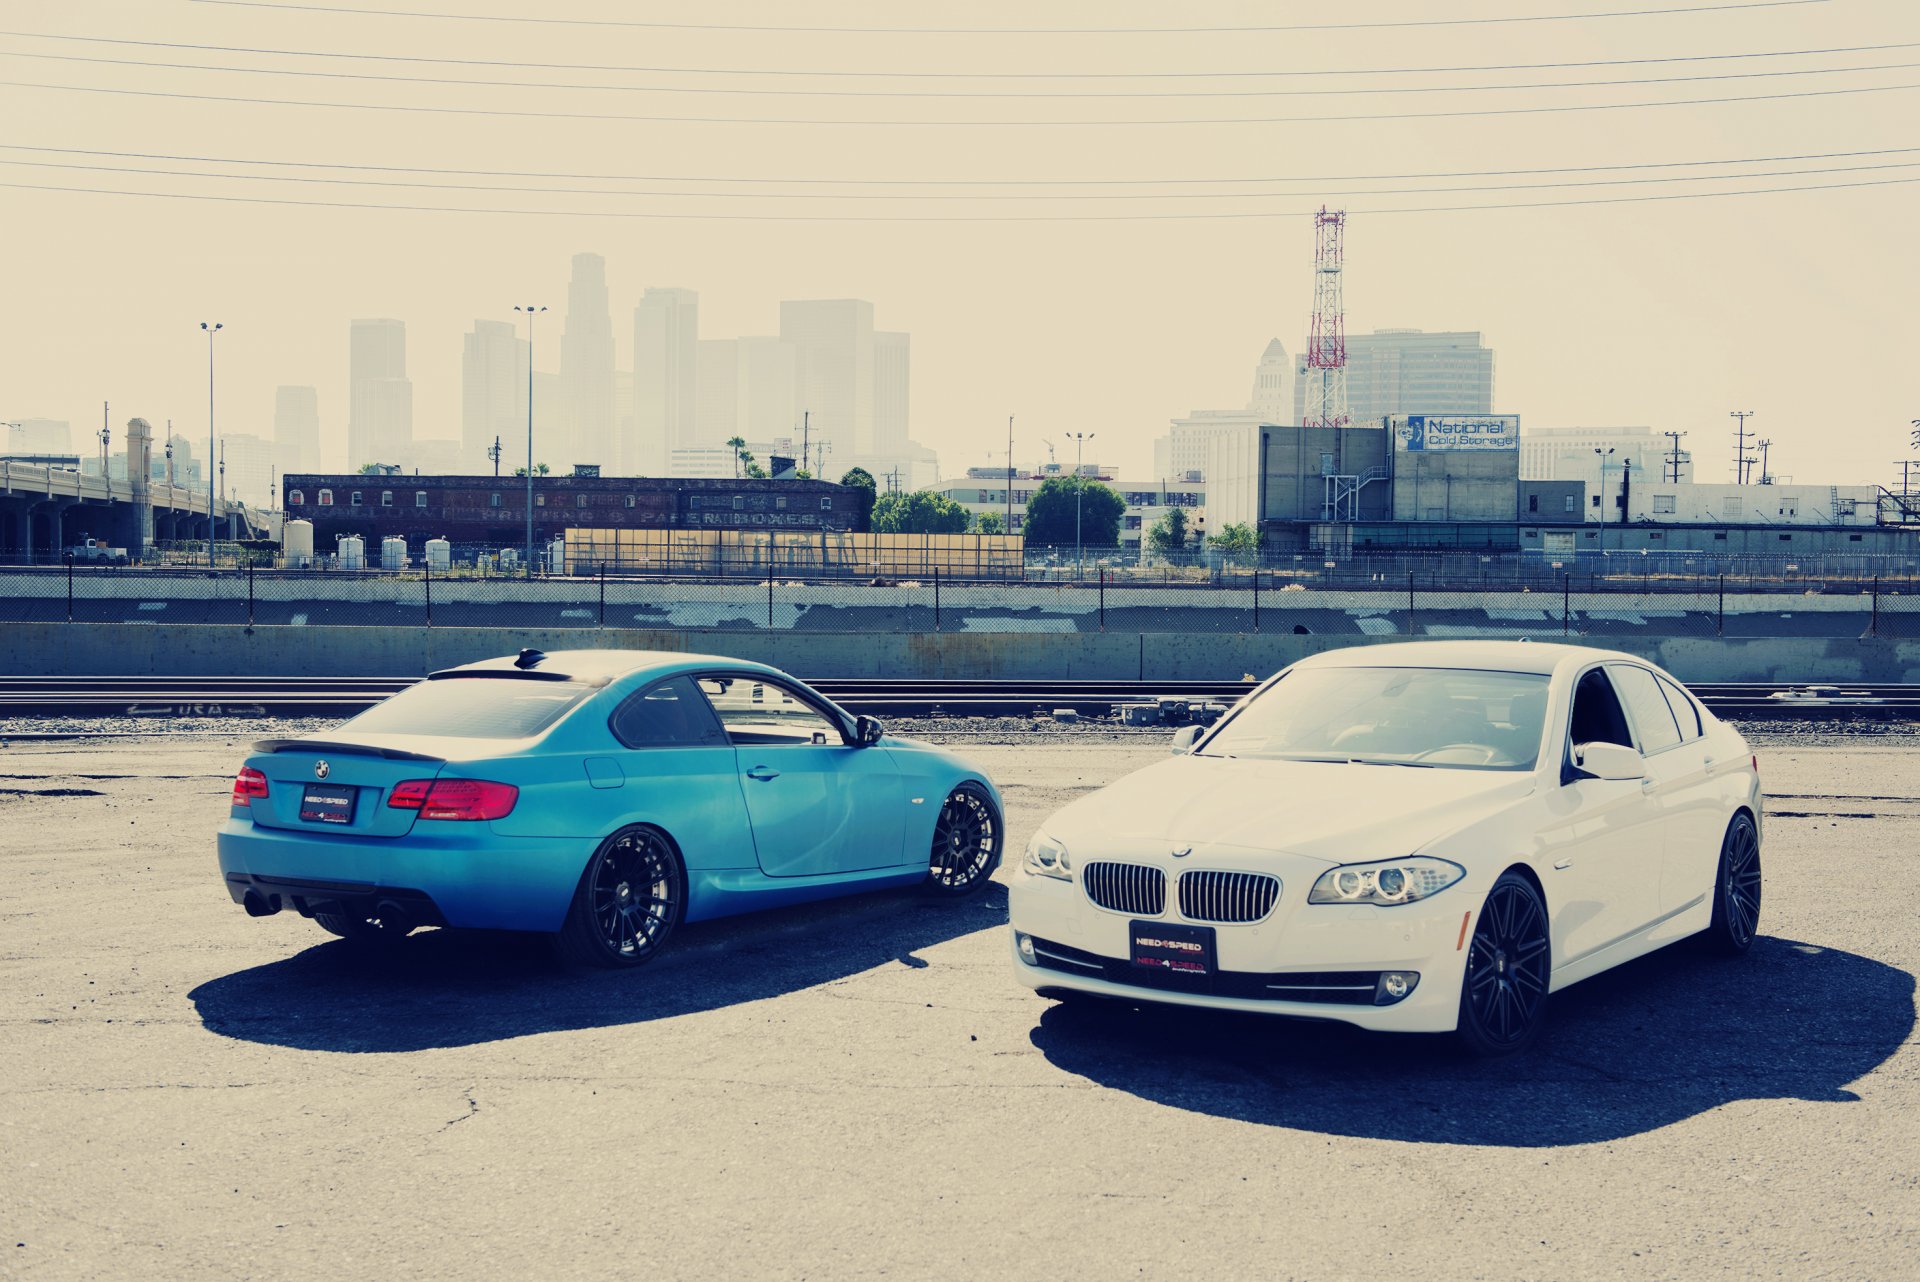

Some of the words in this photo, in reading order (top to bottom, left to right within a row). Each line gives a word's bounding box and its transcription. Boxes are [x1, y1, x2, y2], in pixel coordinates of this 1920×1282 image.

[1429, 420, 1504, 434] National
[1428, 436, 1456, 445] Cold
[1460, 436, 1513, 447] Storage
